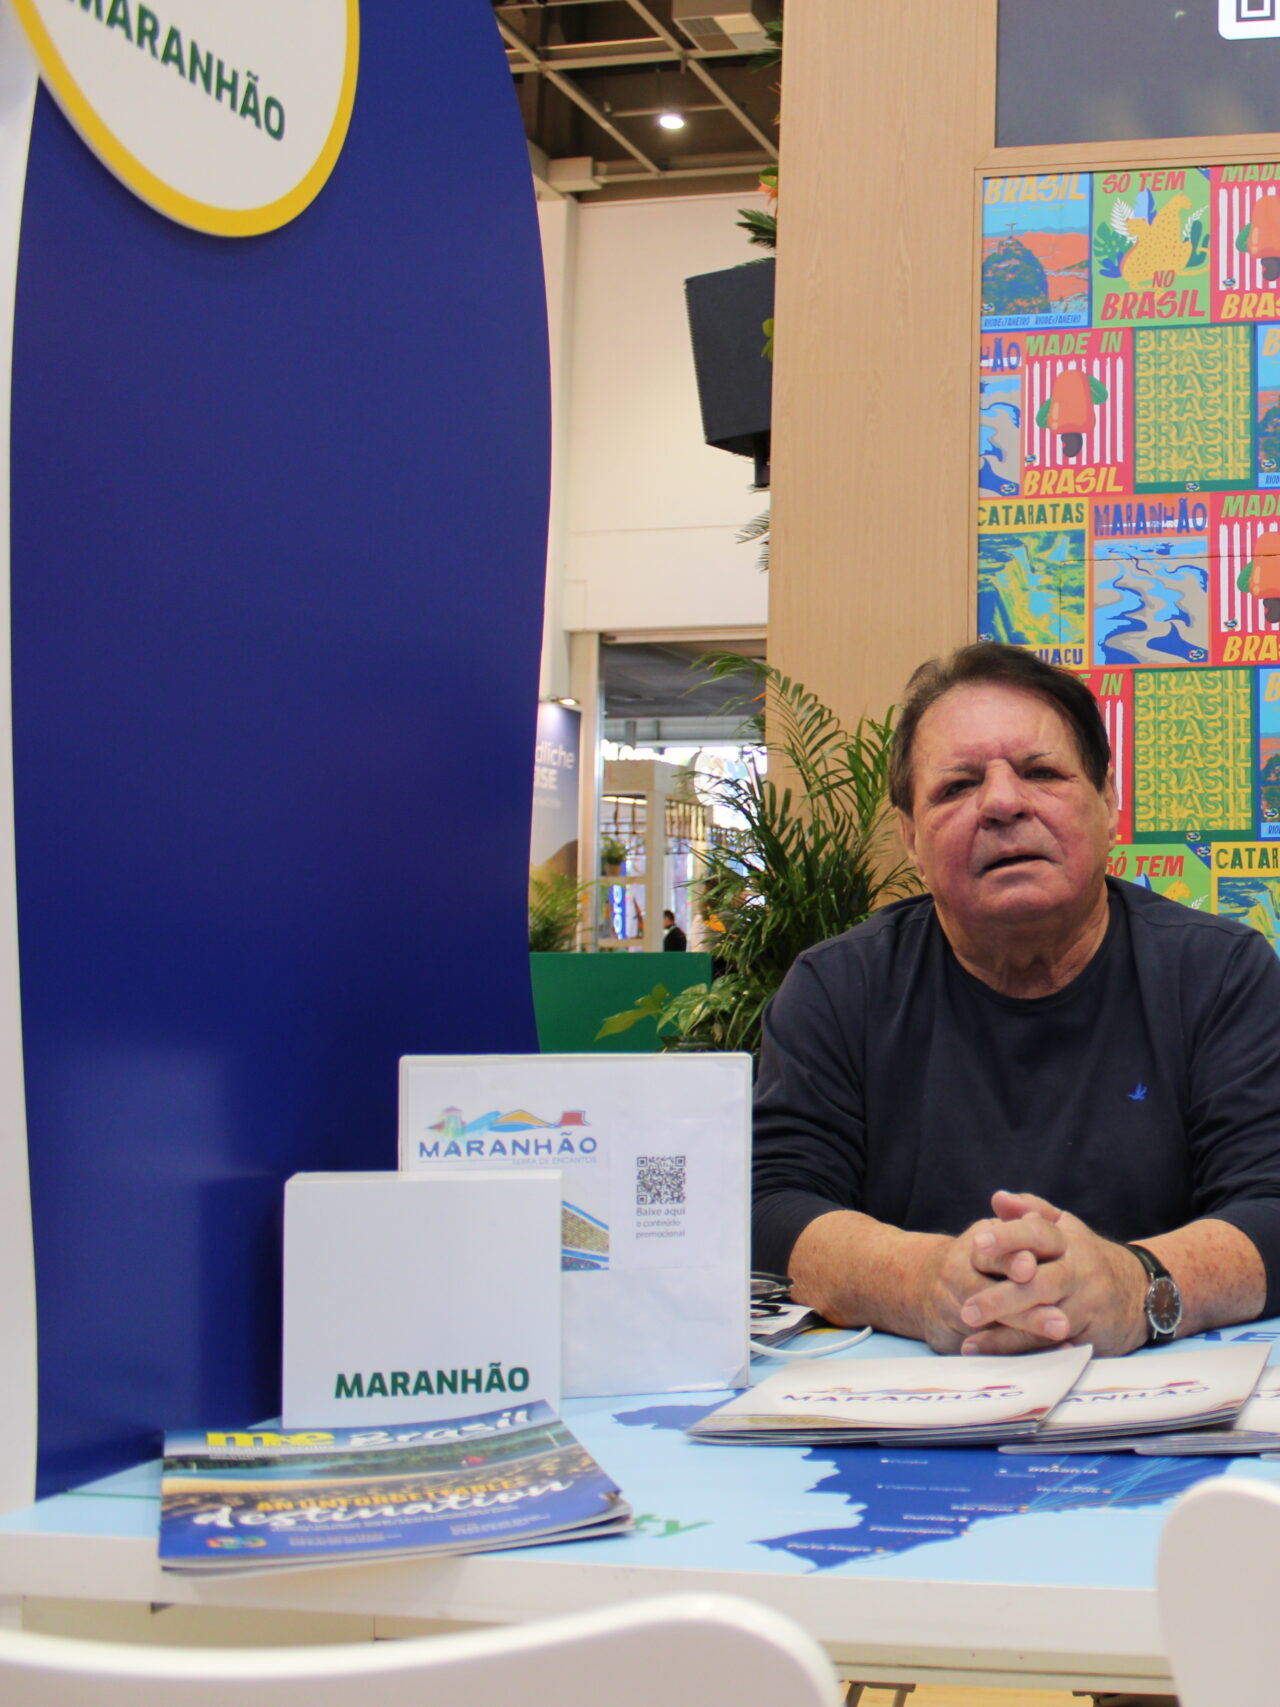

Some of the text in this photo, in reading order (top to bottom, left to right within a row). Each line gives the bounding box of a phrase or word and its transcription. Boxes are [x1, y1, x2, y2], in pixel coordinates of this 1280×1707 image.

[984, 173, 1086, 204] BRASIL
[1102, 170, 1186, 192] SÓ TEM
[1152, 270, 1175, 289] NO
[1101, 289, 1205, 320] BRASIL
[1026, 332, 1123, 355] MADE IN
[1136, 327, 1249, 351] BRASIL
[1136, 350, 1249, 375] BRASIL
[1024, 468, 1123, 495] BRASIL
[979, 503, 1085, 527] CATARATAS
[1100, 673, 1123, 695] IN
[1136, 670, 1250, 696] BRASIL
[1136, 694, 1251, 720] BRASIL
[1133, 855, 1184, 877] TEM
[418, 1131, 597, 1159] MARANHÃO
[636, 1207, 686, 1218] Baixe aqui
[335, 1362, 530, 1399] MARANHÃO
[349, 1410, 530, 1448] Brasil
[193, 1479, 575, 1528] destination
